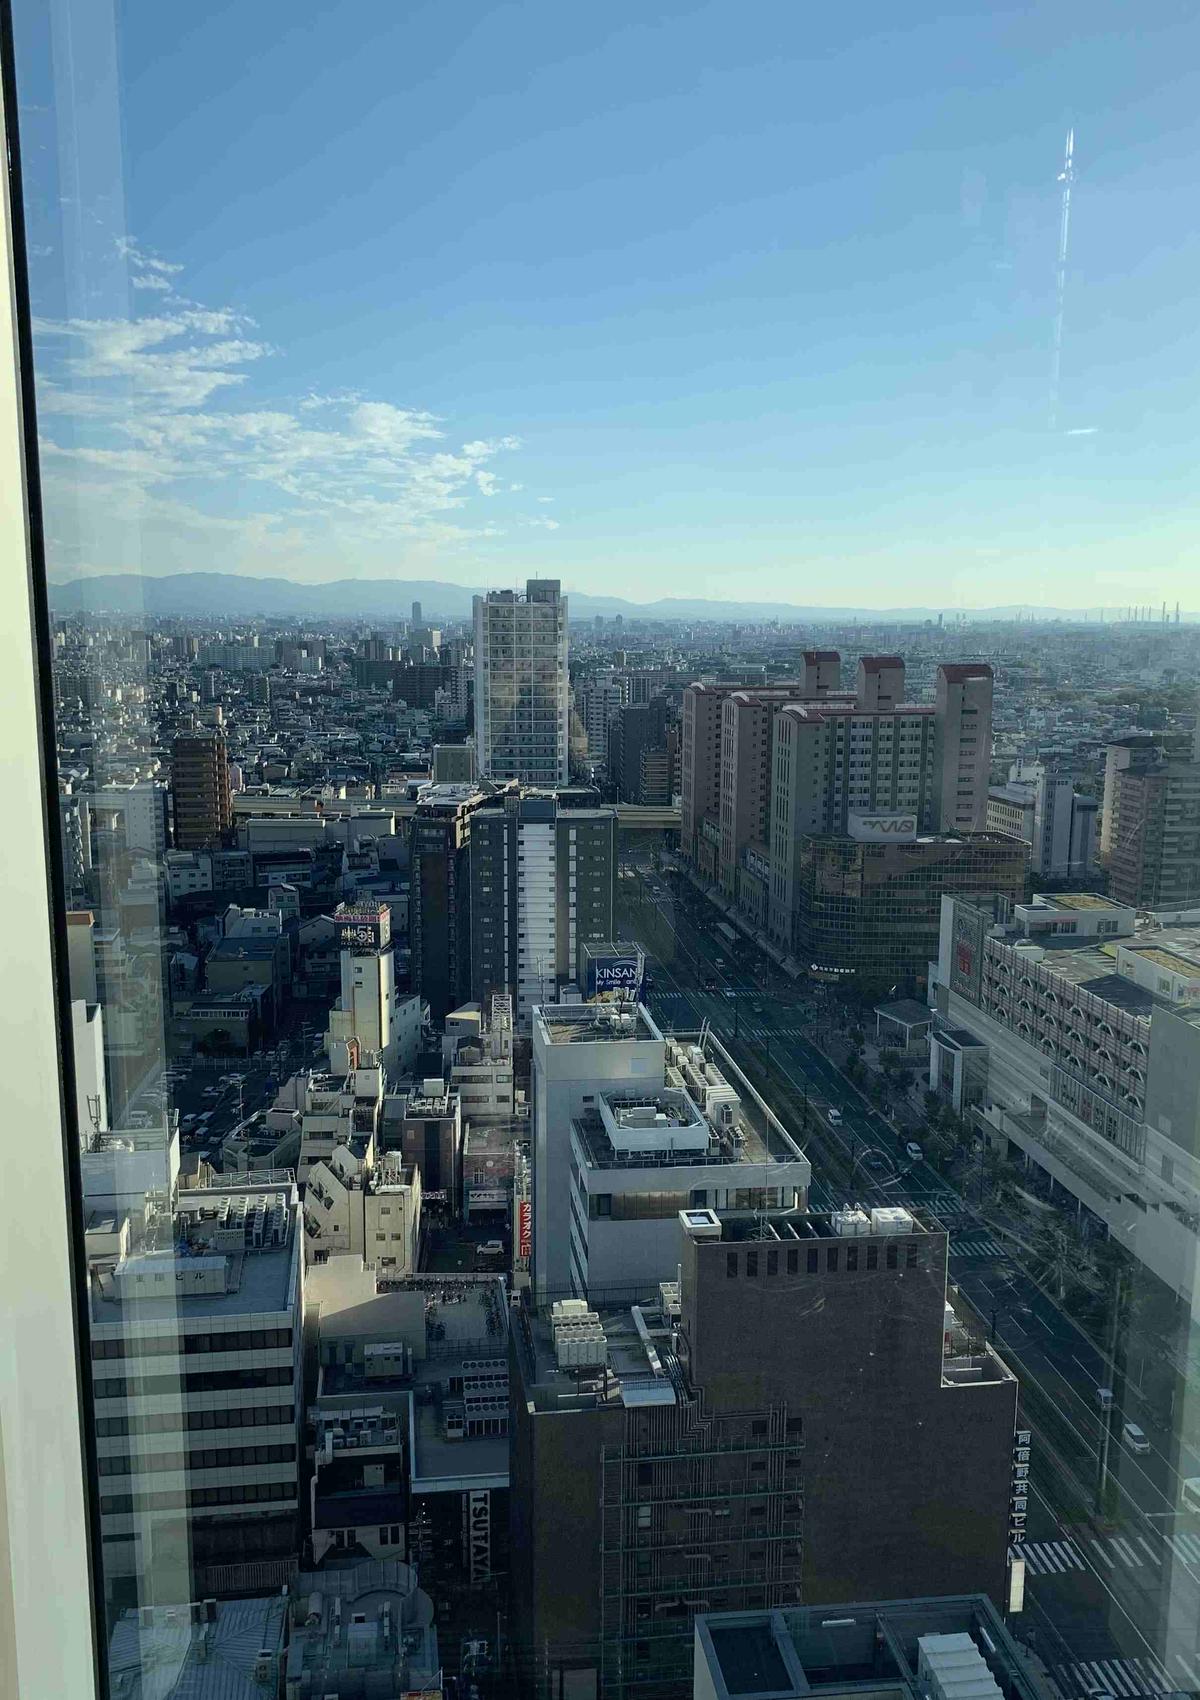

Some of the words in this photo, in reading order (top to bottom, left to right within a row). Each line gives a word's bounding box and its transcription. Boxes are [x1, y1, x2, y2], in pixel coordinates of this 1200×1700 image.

[472, 1493, 489, 1582] TSUTAYA
[1013, 1432, 1031, 1543] 阿倍野共同ビル
